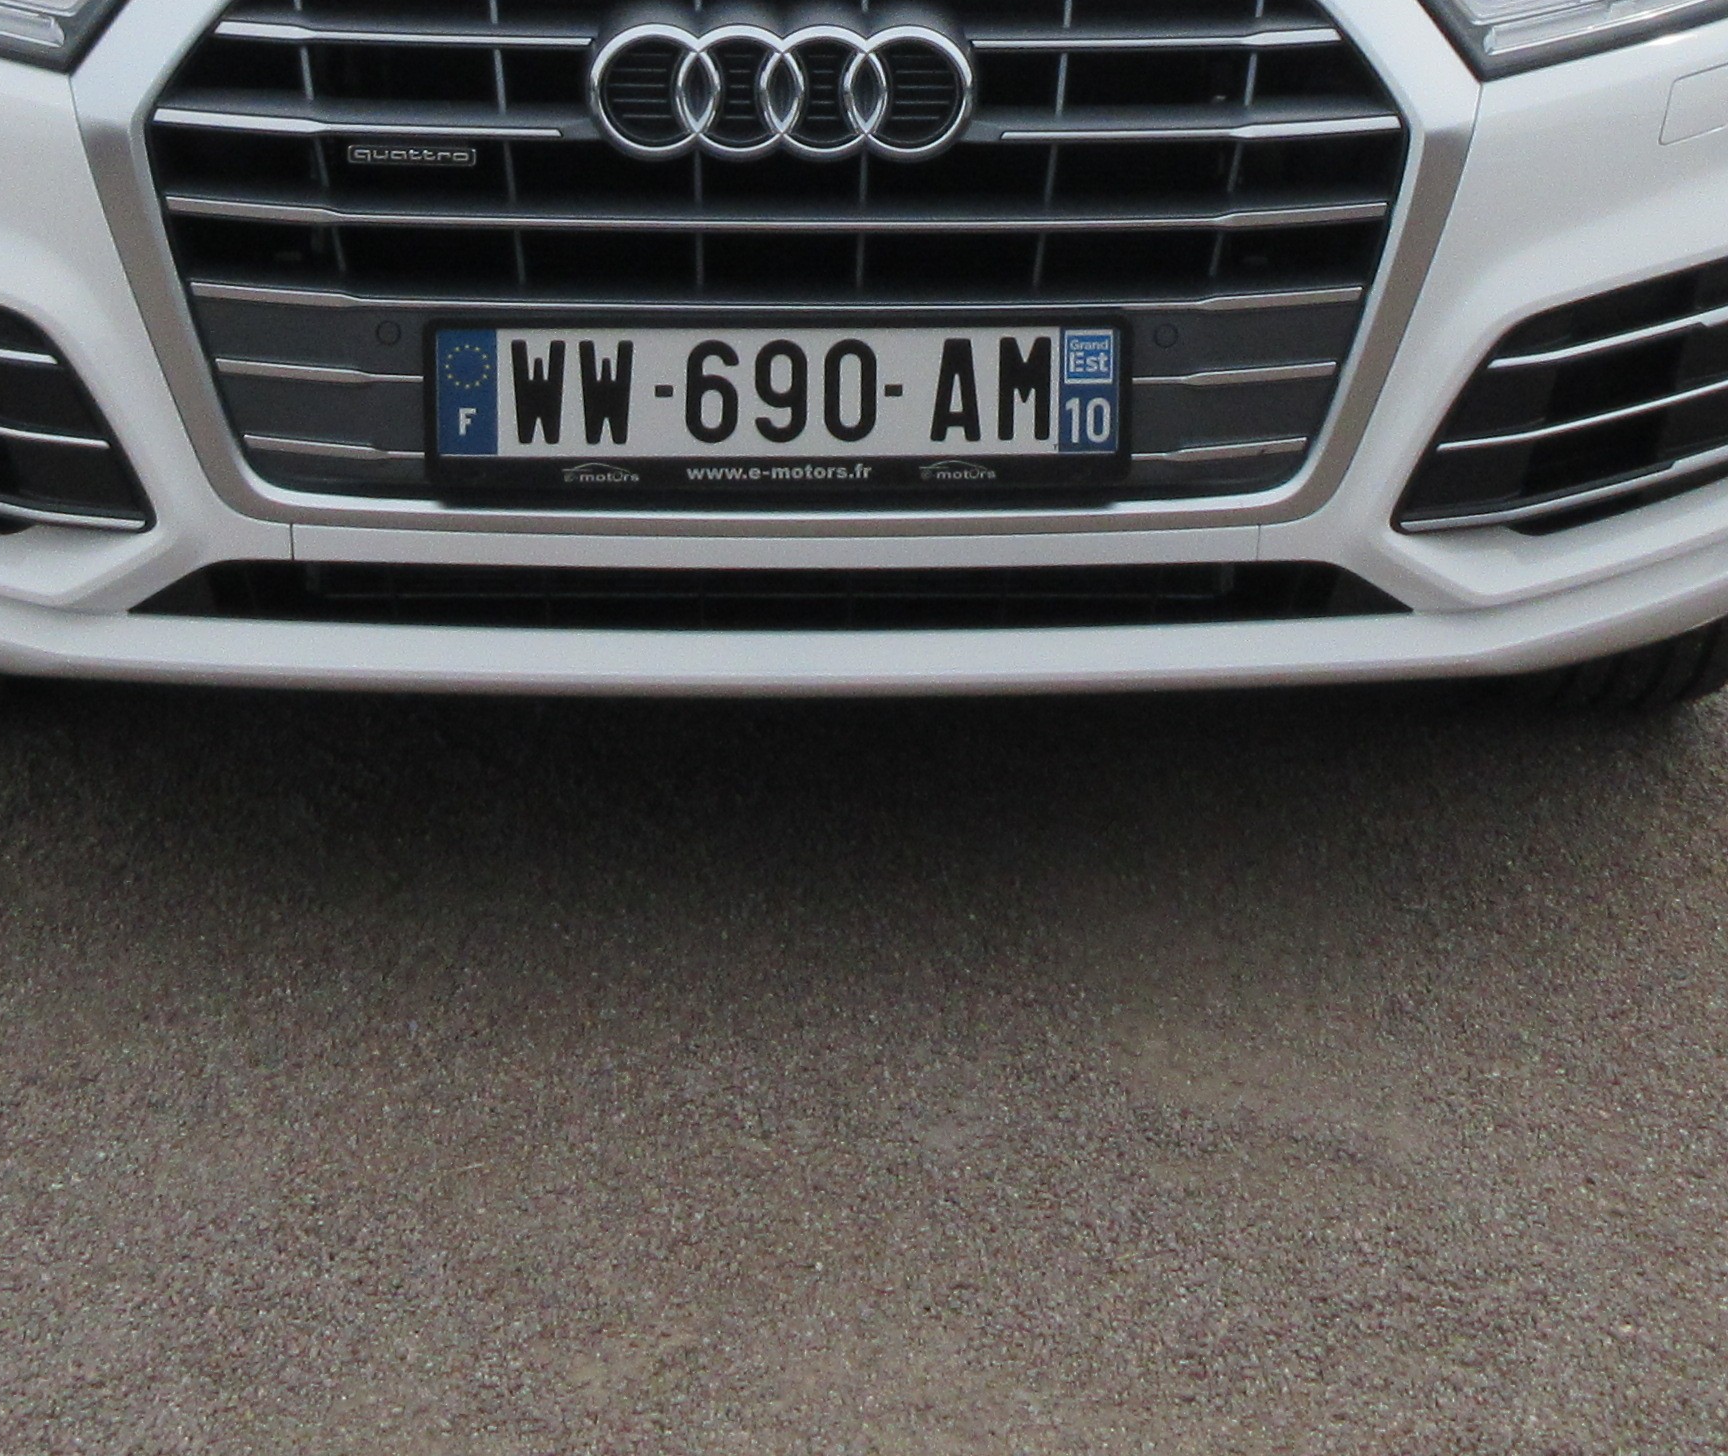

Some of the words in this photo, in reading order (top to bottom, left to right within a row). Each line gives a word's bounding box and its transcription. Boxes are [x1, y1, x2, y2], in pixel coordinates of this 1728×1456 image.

[353, 148, 470, 162] quattro
[1070, 339, 1109, 351] Grand
[1069, 351, 1109, 373] Est
[458, 408, 476, 436] F
[1065, 397, 1111, 443] 10
[686, 463, 872, 481] www.e-motors.fr
